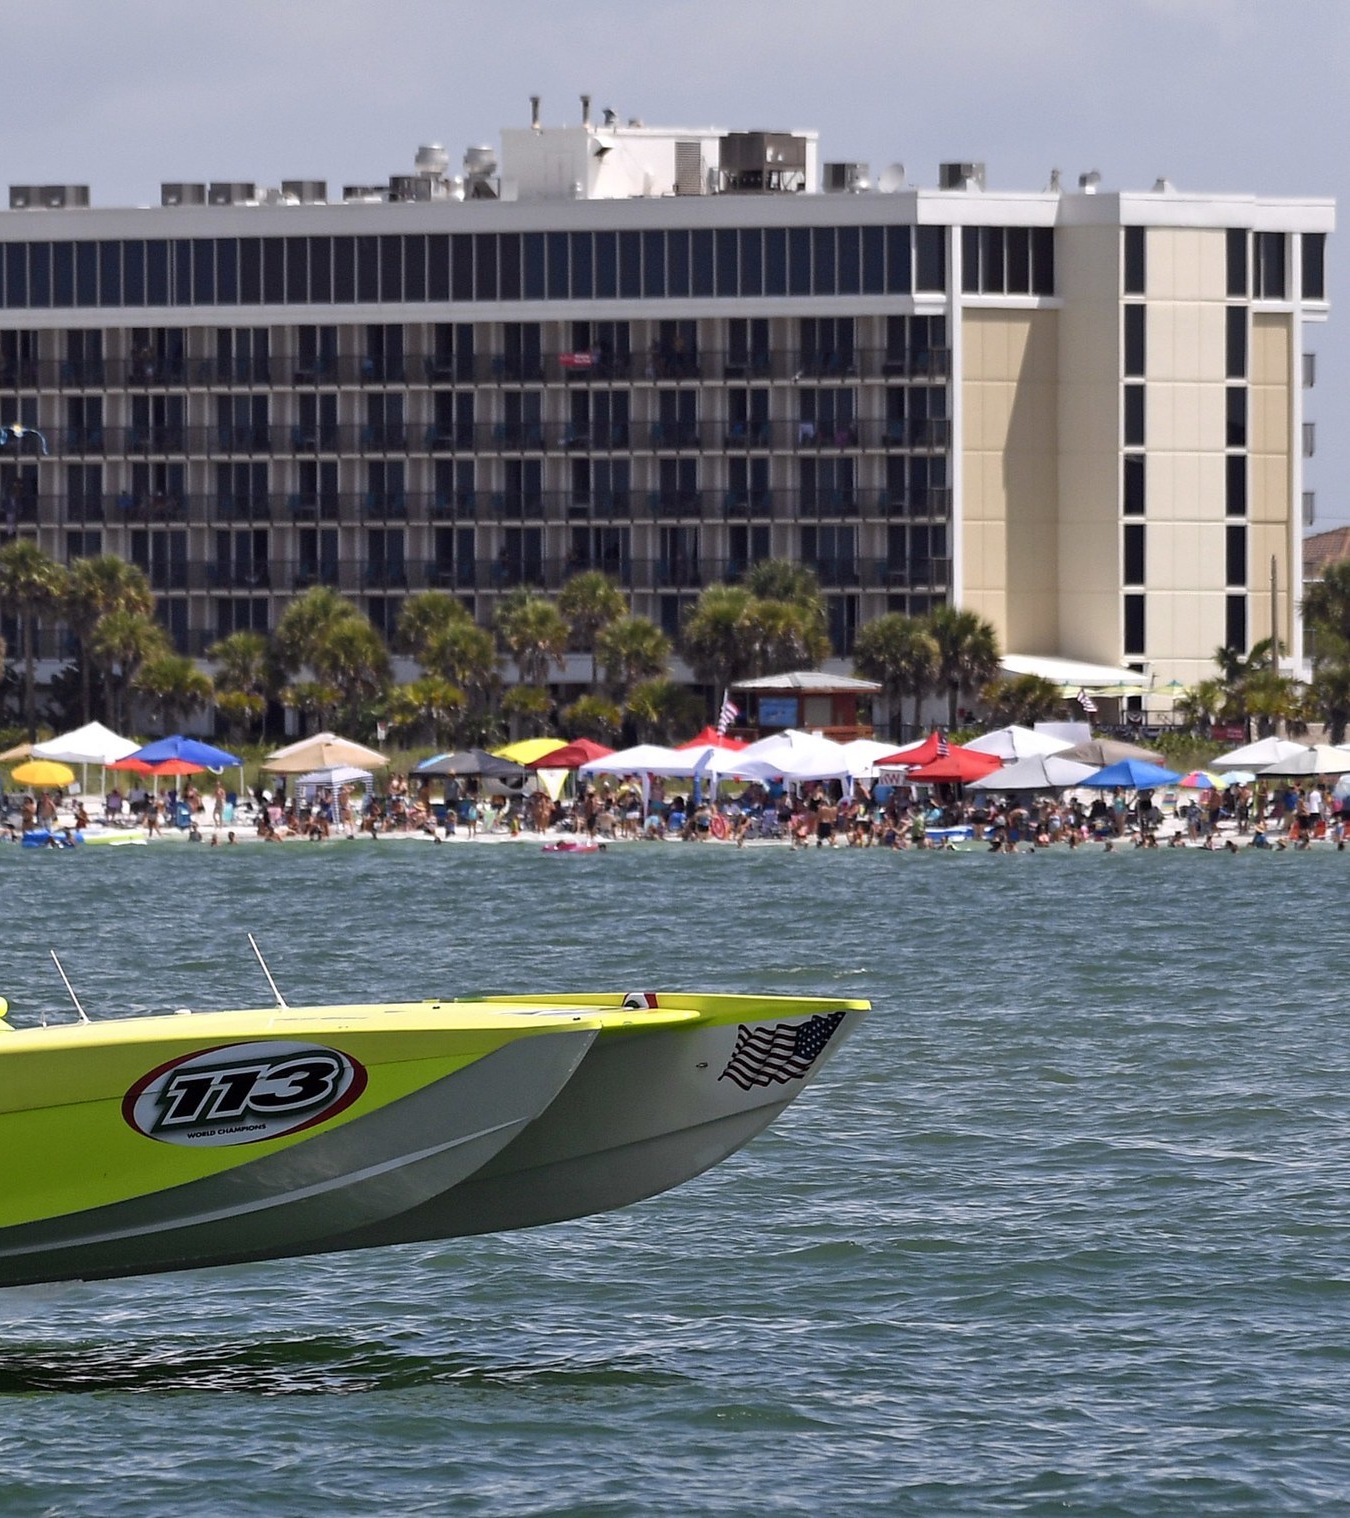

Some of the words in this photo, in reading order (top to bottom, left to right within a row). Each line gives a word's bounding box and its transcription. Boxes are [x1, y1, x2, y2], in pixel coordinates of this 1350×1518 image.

[157, 1054, 341, 1128] 113
[187, 1130, 216, 1139] WORLD
[217, 1123, 267, 1135] CHAMPIONS
